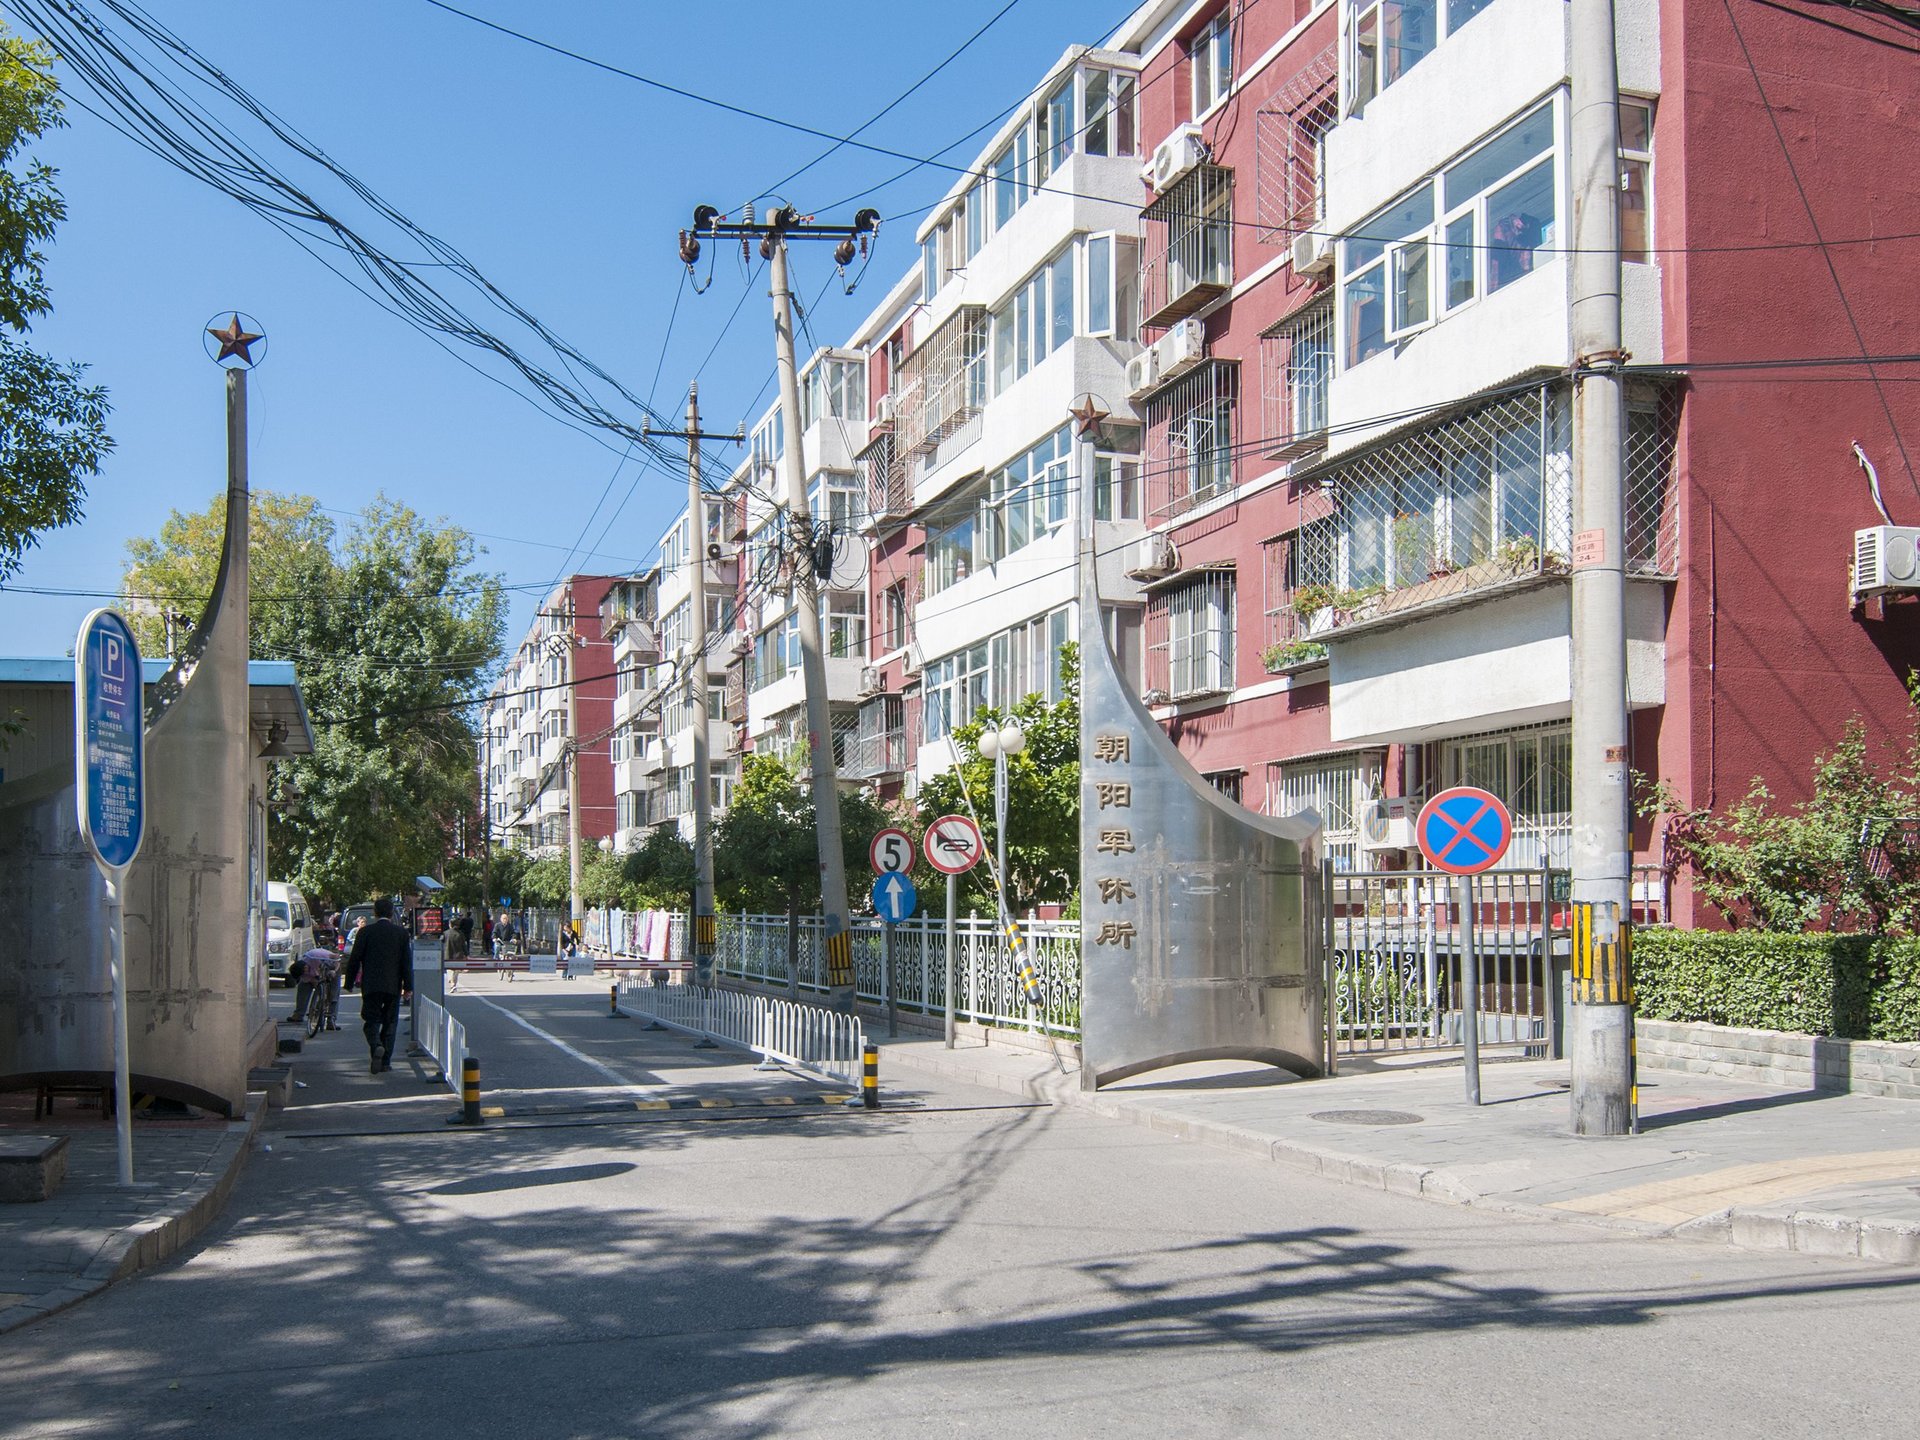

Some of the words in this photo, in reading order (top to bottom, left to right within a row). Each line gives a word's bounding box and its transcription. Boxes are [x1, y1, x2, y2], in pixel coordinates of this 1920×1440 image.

[107, 638, 119, 674] P
[103, 682, 122, 696] 收费停车
[883, 838, 901, 872] 5
[1094, 735, 1136, 950] 朝阳军休所
